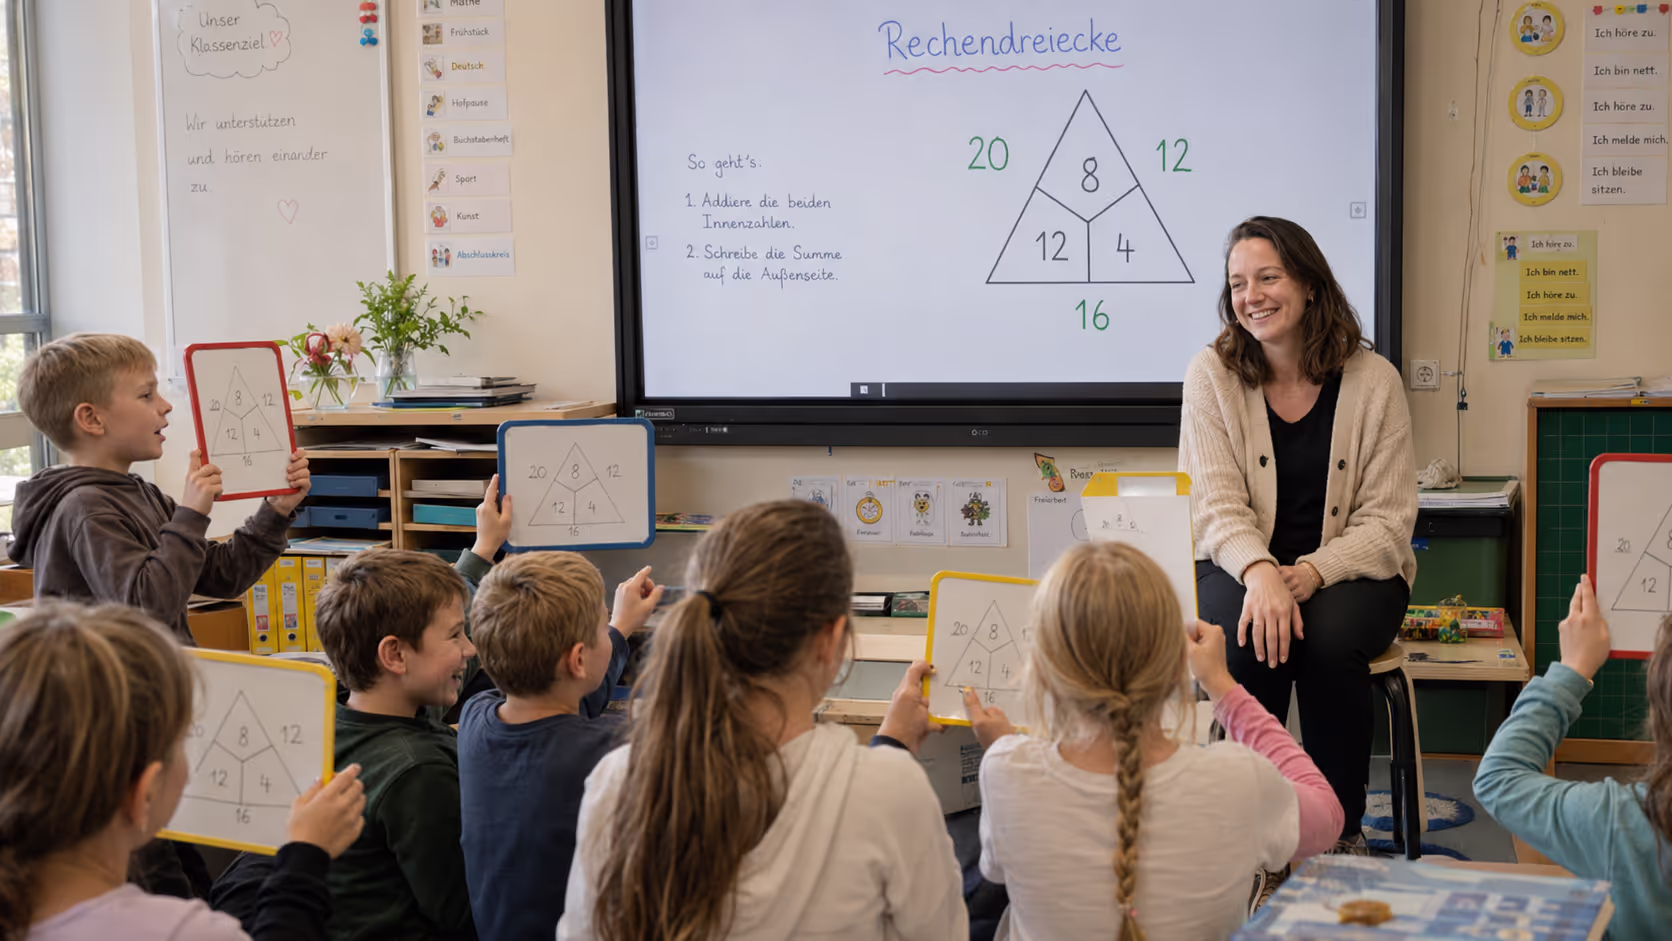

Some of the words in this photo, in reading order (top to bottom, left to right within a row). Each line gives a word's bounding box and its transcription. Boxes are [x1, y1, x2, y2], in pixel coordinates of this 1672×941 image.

[199, 11, 241, 28] Unser
[878, 17, 1122, 60] Rechendreiecke
[1595, 28, 1612, 38] Ich
[1615, 27, 1638, 38] höre
[1641, 29, 1656, 37] zu.
[190, 32, 265, 53] Klassenziel
[451, 62, 484, 71] Deutsch
[1594, 66, 1611, 76] Ich
[1614, 64, 1630, 76] bin
[1633, 65, 1658, 75] nett.
[452, 98, 489, 111] Hofpause
[1593, 101, 1610, 112] Ich
[1613, 100, 1636, 111] höre
[1640, 103, 1655, 111] zu.
[185, 112, 207, 131] Wir
[1592, 134, 1609, 145] Ich
[1612, 134, 1641, 145] melde
[1643, 134, 1669, 145] mich.
[187, 147, 215, 165] und
[224, 147, 262, 164] hören
[272, 145, 328, 161] einander
[688, 153, 706, 170] So
[968, 136, 1009, 171] 20
[1156, 138, 1192, 172] 12
[1081, 156, 1100, 193] 8
[1592, 166, 1609, 177] Ich
[1612, 166, 1643, 177] bleibe
[455, 175, 477, 185] Sport
[1591, 184, 1626, 195] sitzen.
[685, 193, 697, 208] 1.
[702, 192, 752, 208] Addiere
[759, 193, 779, 208] die
[788, 193, 831, 208] beiden
[456, 212, 480, 221] Kunst
[702, 213, 795, 229] Innenzahlen.
[686, 244, 699, 259] 2.
[704, 244, 758, 260] Schreibe
[765, 246, 786, 260] die
[793, 244, 843, 260] Summe
[1036, 230, 1069, 261] 12
[1116, 232, 1136, 263] 4
[1531, 240, 1544, 248] Ich
[703, 266, 726, 286] auf
[732, 266, 752, 281] die
[761, 266, 839, 289] Außenseite.
[1526, 267, 1540, 276] Ich
[1543, 267, 1556, 276] bin
[1558, 268, 1579, 276] nett.
[1527, 290, 1541, 299] Ich
[1075, 299, 1110, 331] 16
[1523, 312, 1538, 321] Ich
[1540, 312, 1565, 321] melde
[1519, 335, 1533, 343] Ich
[1534, 335, 1558, 343] bleibe
[209, 399, 221, 411] 20
[235, 389, 242, 406] 8
[262, 393, 275, 407] 12
[226, 428, 238, 440] 12
[253, 427, 261, 440] 4
[242, 455, 253, 467] 16
[528, 465, 548, 479] 20
[571, 463, 580, 480] 8
[606, 464, 622, 478] 12
[552, 501, 565, 514] 12
[587, 500, 596, 514] 4
[568, 525, 579, 537] 16
[1616, 536, 1631, 552] 20
[1641, 577, 1657, 594] 12
[951, 620, 969, 637] 20
[988, 623, 998, 641] 8
[968, 660, 982, 675] 12
[1001, 663, 1010, 679] 4
[984, 690, 996, 704] 16
[238, 725, 249, 747] 8
[280, 724, 303, 745] 12
[209, 769, 228, 787] 12
[260, 774, 272, 793] 4
[235, 808, 251, 825] 16
